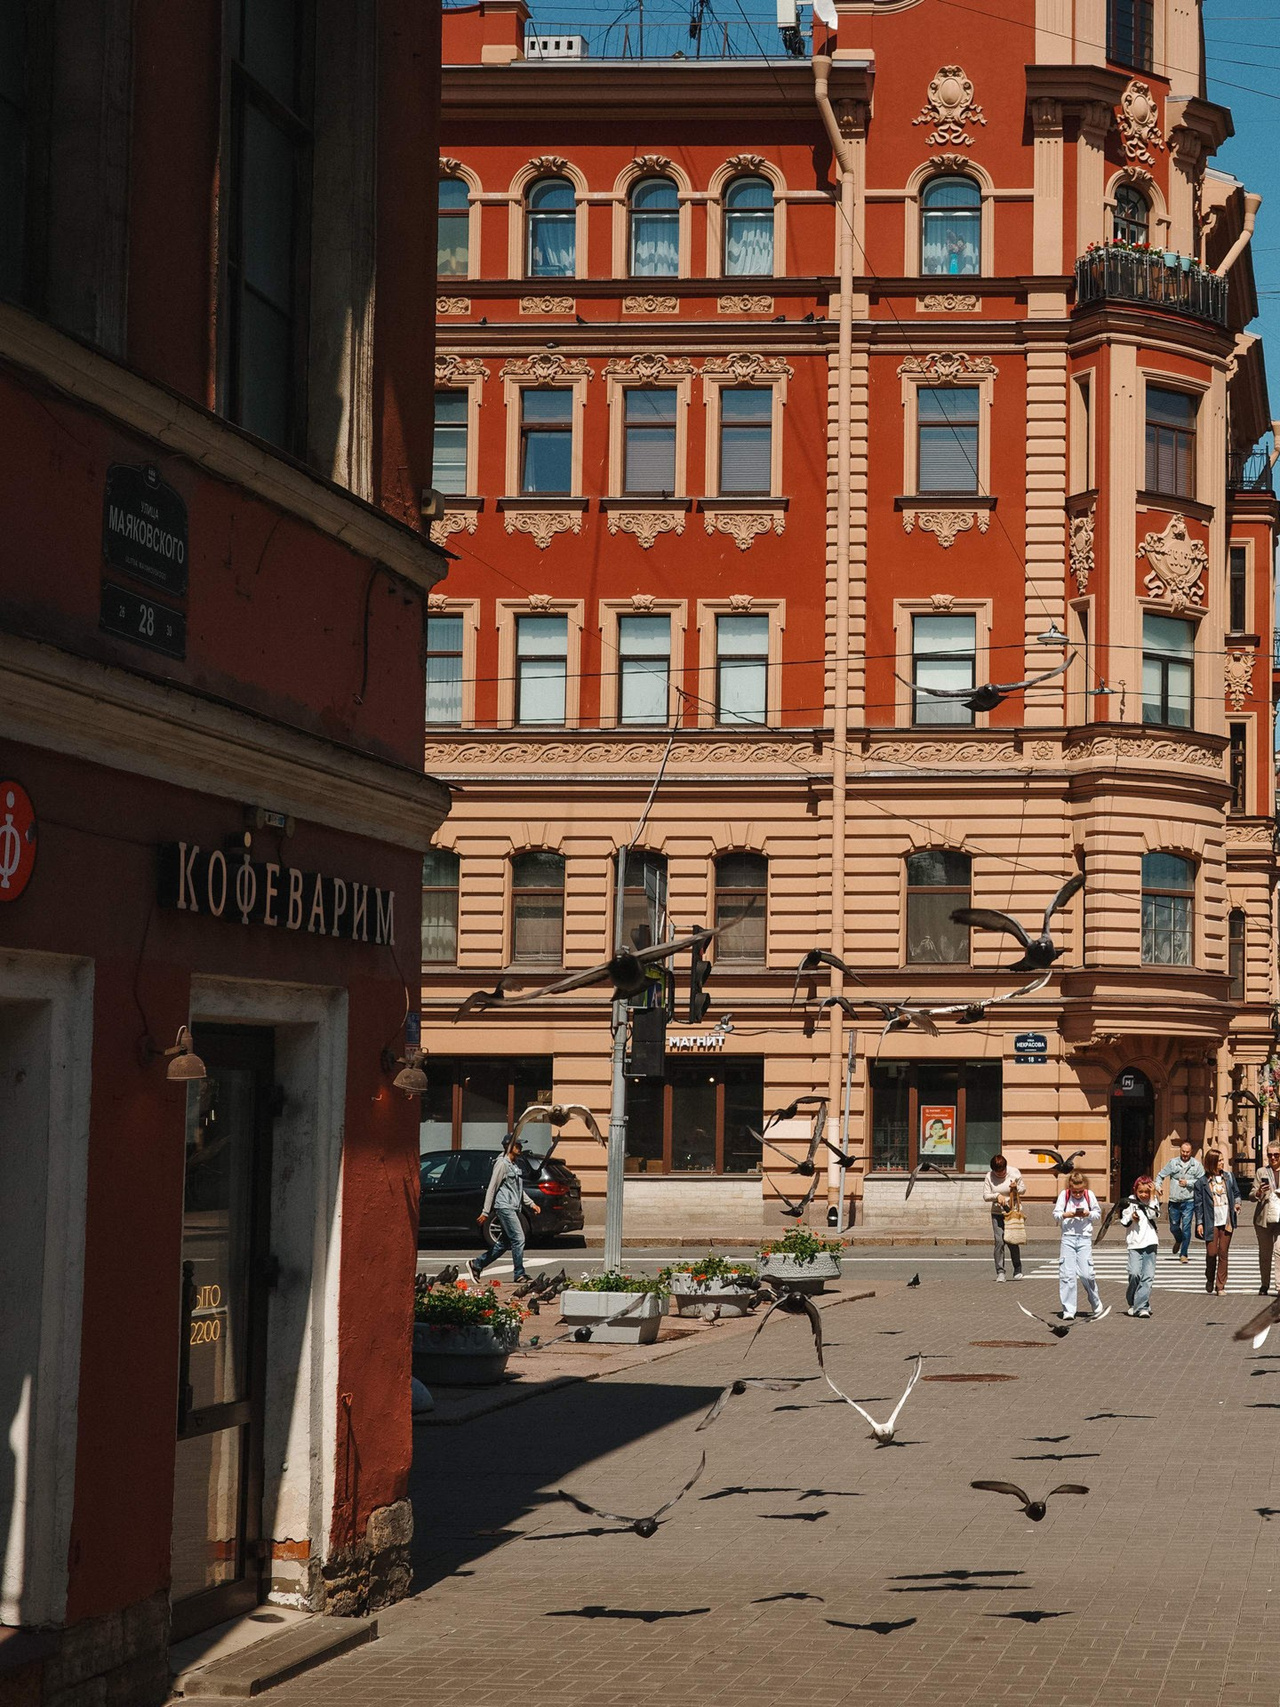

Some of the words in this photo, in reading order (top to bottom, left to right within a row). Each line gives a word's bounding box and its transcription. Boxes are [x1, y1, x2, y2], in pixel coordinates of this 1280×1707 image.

[140, 501, 159, 520] УЛИЦА
[109, 504, 184, 564] МАЯКОВСКОГО
[138, 603, 154, 637] 28
[176, 831, 396, 946] КОФЕВАРИМ
[669, 1036, 725, 1047] МАГНИТ
